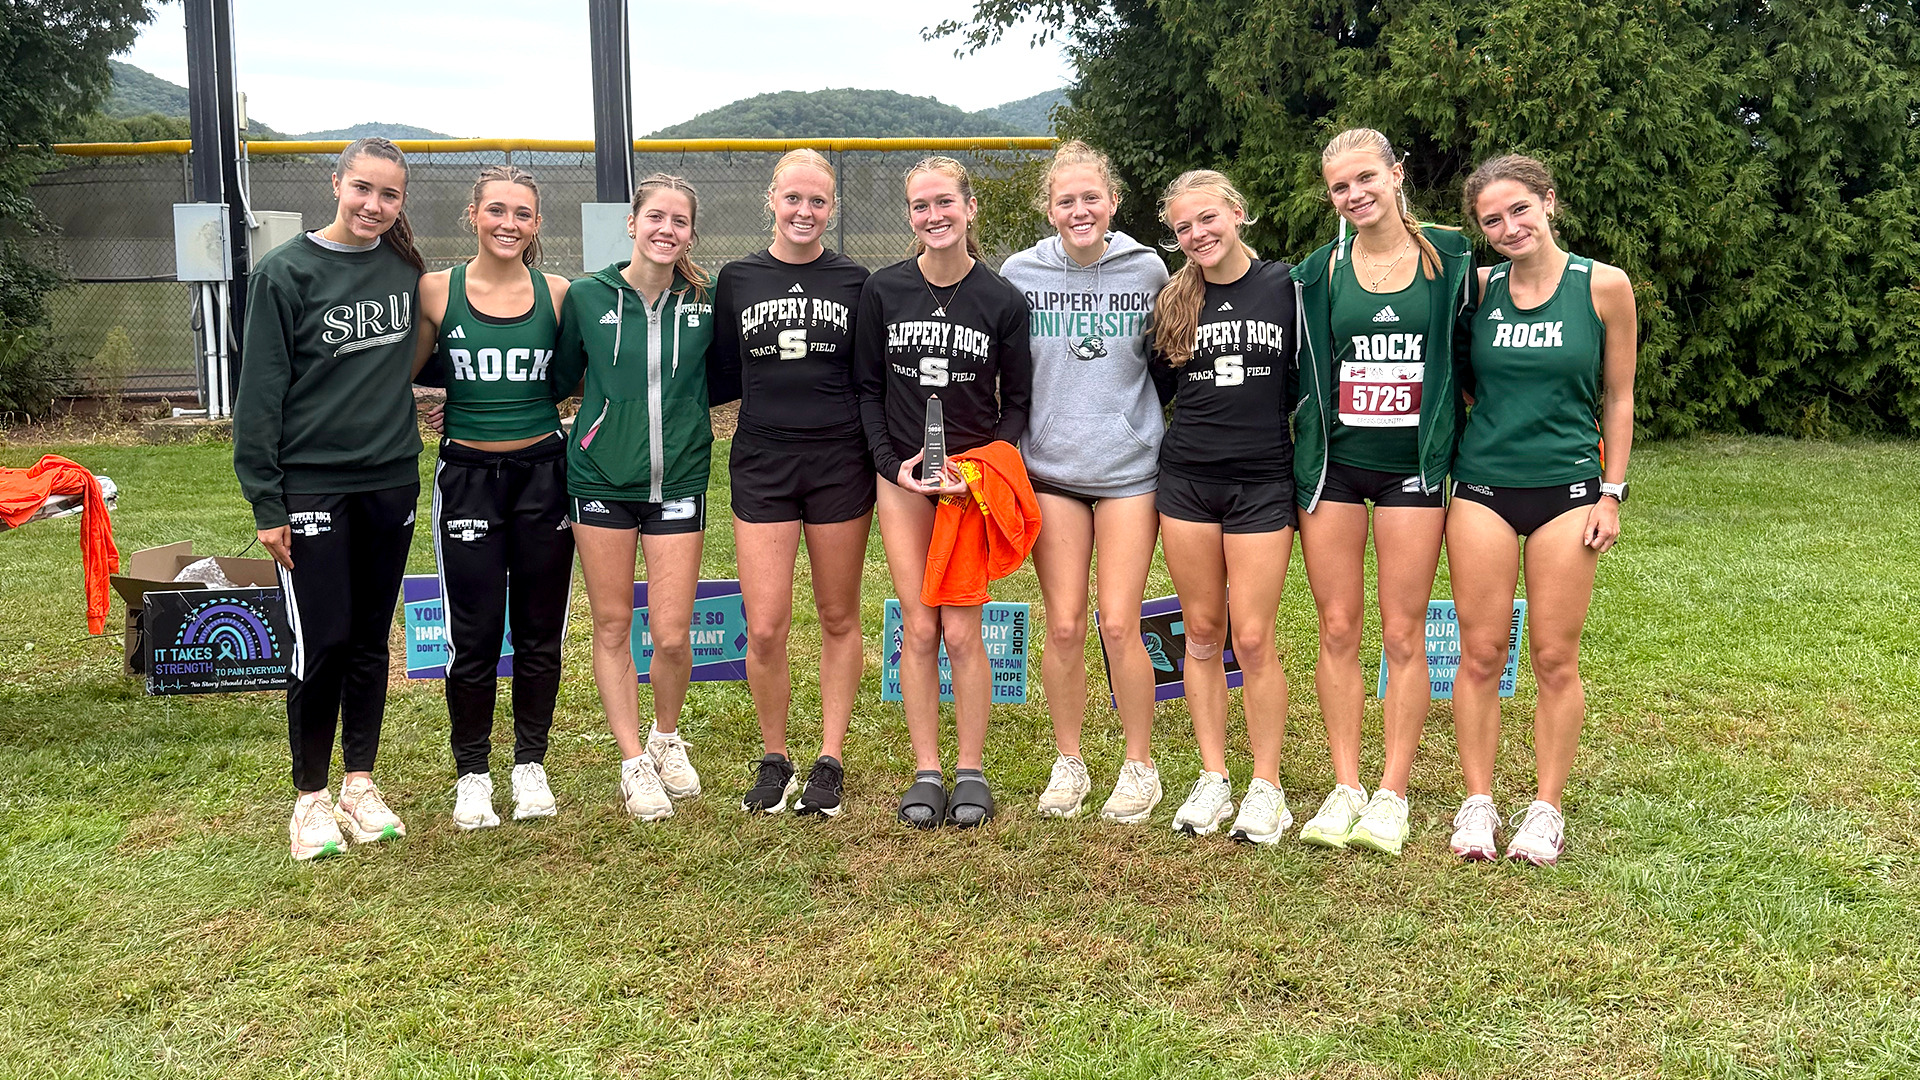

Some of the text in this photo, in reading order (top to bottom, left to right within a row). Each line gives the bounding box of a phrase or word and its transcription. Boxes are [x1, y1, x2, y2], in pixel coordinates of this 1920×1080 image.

[1025, 290, 1150, 311] SLIPPERY ROCK
[322, 291, 411, 344] SRU
[741, 297, 849, 335] SLIPPERY ROCK
[744, 319, 848, 341] UNIVERSITY
[1029, 312, 1149, 337] UNIVERSITY
[887, 321, 990, 358] SLIPPERY ROCK
[1193, 320, 1283, 351] PPERY ROCK
[1492, 320, 1563, 348] ROCK
[750, 342, 836, 357] TRACK FIELD
[778, 328, 807, 360] S
[1351, 333, 1424, 360] ROCK
[889, 346, 987, 364] UNIVERSITY
[450, 347, 553, 382] ROCK
[919, 356, 949, 387] S
[1214, 354, 1245, 387] S
[892, 363, 976, 382] TRACK FIELD
[1188, 366, 1271, 381] TRACK FIELD
[1352, 385, 1412, 412] 5725
[1467, 484, 1494, 497] adidas
[1569, 482, 1587, 499] S
[583, 504, 610, 514] adidas
[304, 523, 318, 536] S
[462, 530, 475, 541] S
[414, 607, 442, 621] YOU
[706, 611, 724, 625] SO
[989, 609, 1009, 622] UP
[981, 625, 1008, 640] ORY
[1012, 611, 1024, 655] SUICIDE
[1425, 623, 1455, 637] OUR
[154, 647, 213, 661] IT TAKES
[417, 644, 440, 653] DON'T
[693, 647, 723, 657] TRYING
[986, 643, 1007, 655] YET
[156, 662, 213, 675] STRENGTH
[215, 665, 287, 677] TO PAIN EVERYDAY
[990, 658, 1022, 669] THE PAIN
[995, 672, 1022, 682] HOPE
[1436, 668, 1455, 678] NOT
[201, 681, 219, 689] Story
[220, 679, 243, 687] Should
